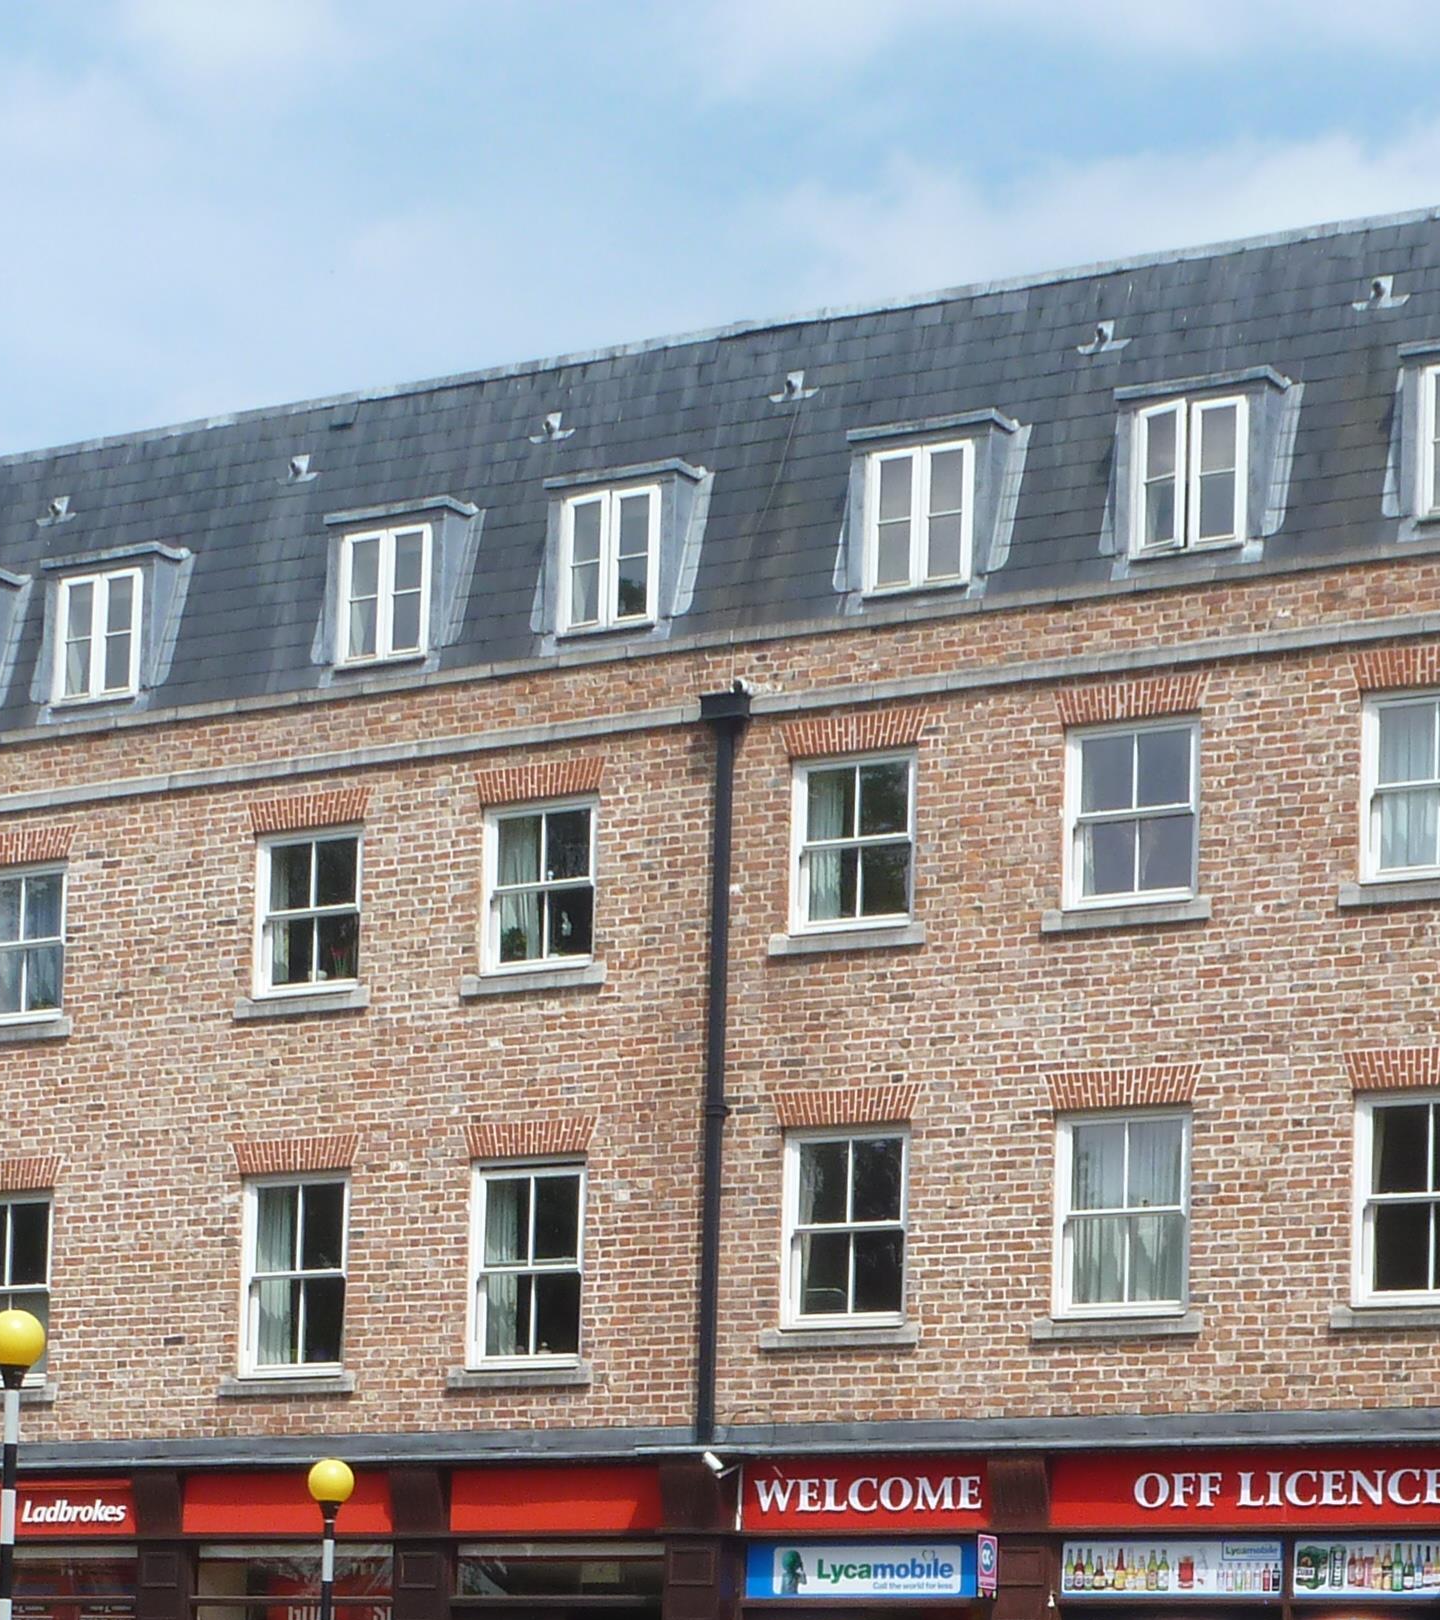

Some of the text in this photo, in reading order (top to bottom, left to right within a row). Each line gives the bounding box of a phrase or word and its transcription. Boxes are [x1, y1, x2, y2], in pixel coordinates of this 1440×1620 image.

[754, 1476, 982, 1512] WELCOME
[1133, 1472, 1223, 1508] OFF
[21, 1499, 127, 1523] Ladbrokes
[817, 1558, 954, 1584] Lycamobile
[873, 1582, 886, 1590] Call
[888, 1582, 901, 1590] the
[903, 1582, 924, 1590] world
[926, 1582, 936, 1590] for
